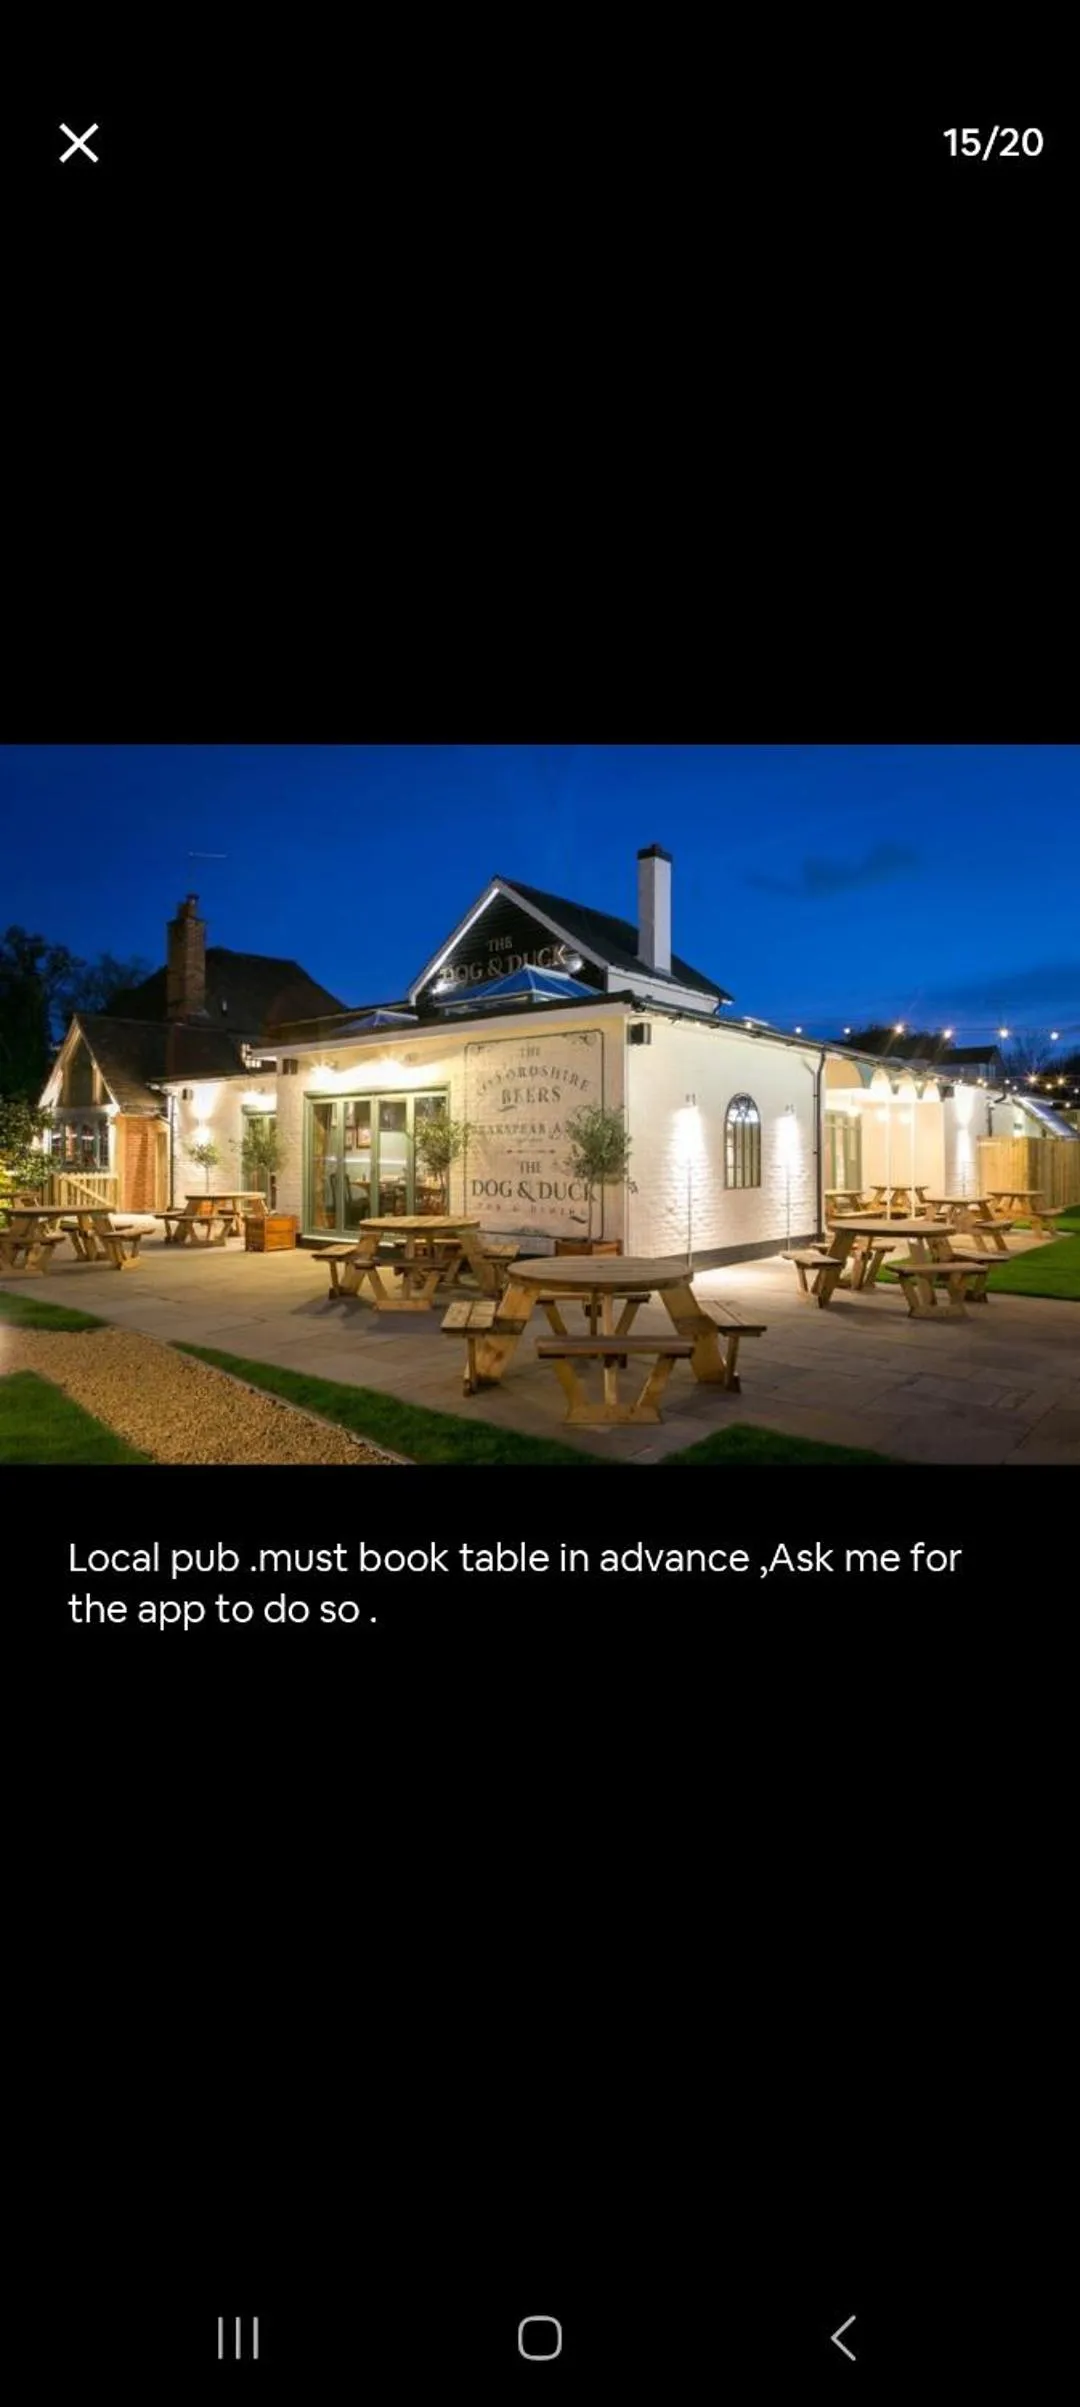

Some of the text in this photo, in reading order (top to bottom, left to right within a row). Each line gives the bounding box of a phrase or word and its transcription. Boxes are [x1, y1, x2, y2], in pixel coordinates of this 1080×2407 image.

[487, 936, 513, 952] THE
[439, 944, 567, 983] DOG & DUCK
[502, 1086, 562, 1105] BEERS
[519, 1161, 542, 1174] THE
[472, 1179, 599, 1203] DOG & DUCK
